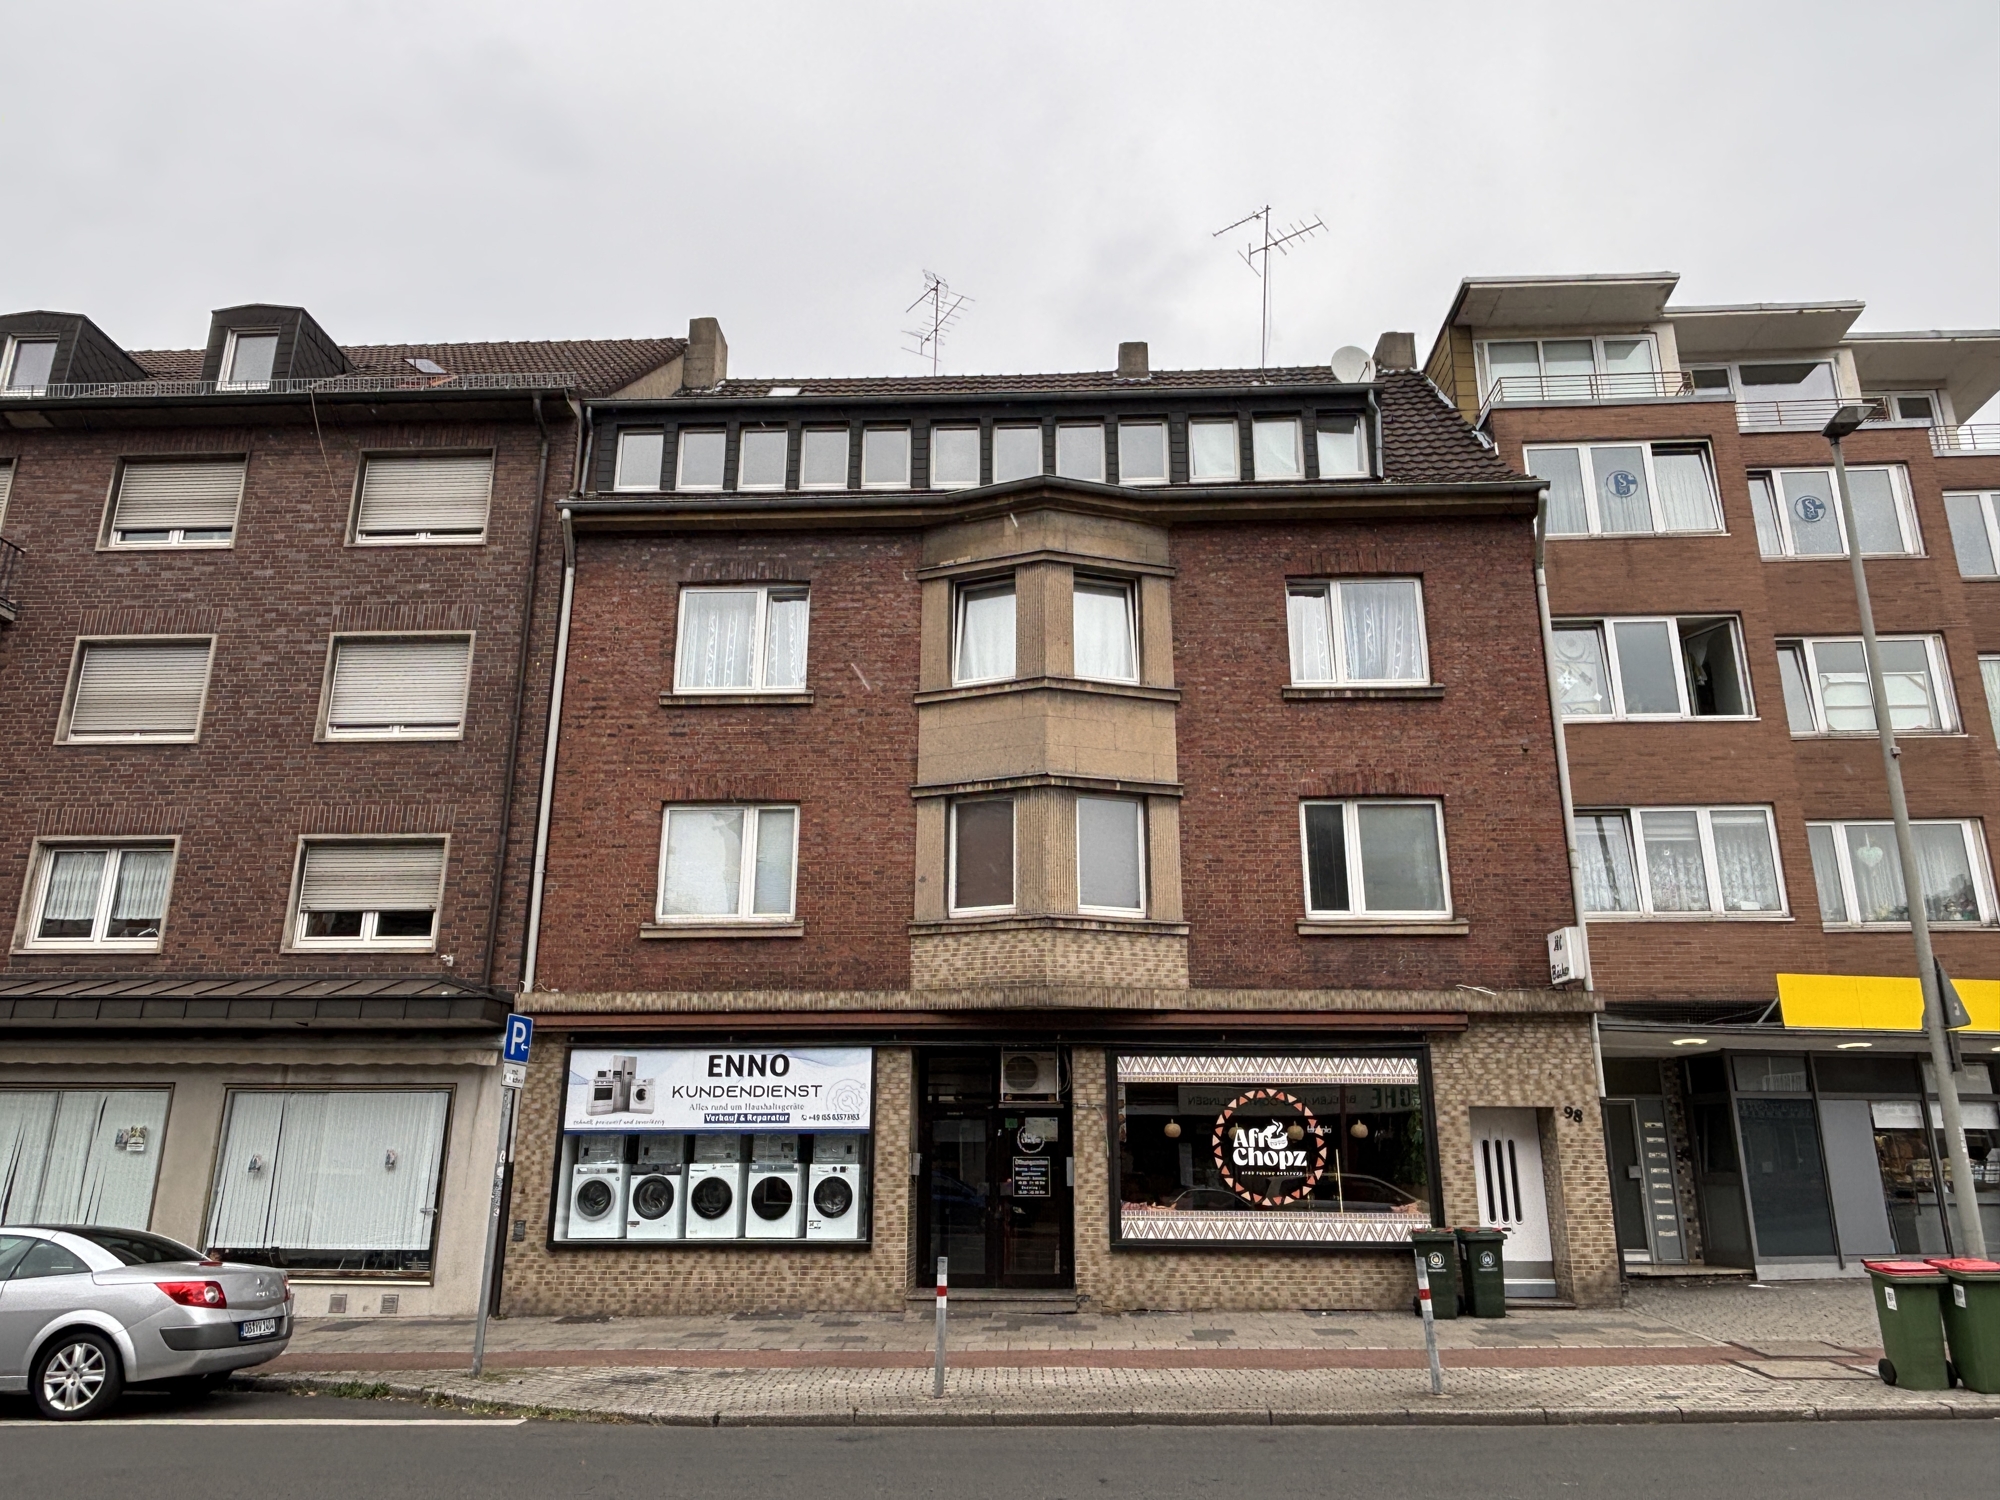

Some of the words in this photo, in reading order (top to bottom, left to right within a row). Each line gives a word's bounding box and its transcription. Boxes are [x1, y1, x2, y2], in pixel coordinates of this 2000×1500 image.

[510, 1021, 526, 1055] P
[707, 1053, 790, 1078] ENNO
[672, 1084, 823, 1099] KUNDENDIENST
[689, 1102, 709, 1111] Alles
[711, 1103, 728, 1111] rund
[745, 1102, 805, 1112] Haushaltsgeräte
[1563, 1105, 1583, 1123] 98
[705, 1113, 738, 1124] Verkauf
[739, 1114, 746, 1122] &
[747, 1113, 789, 1124] Reparatur
[1232, 1147, 1308, 1170] Chopz
